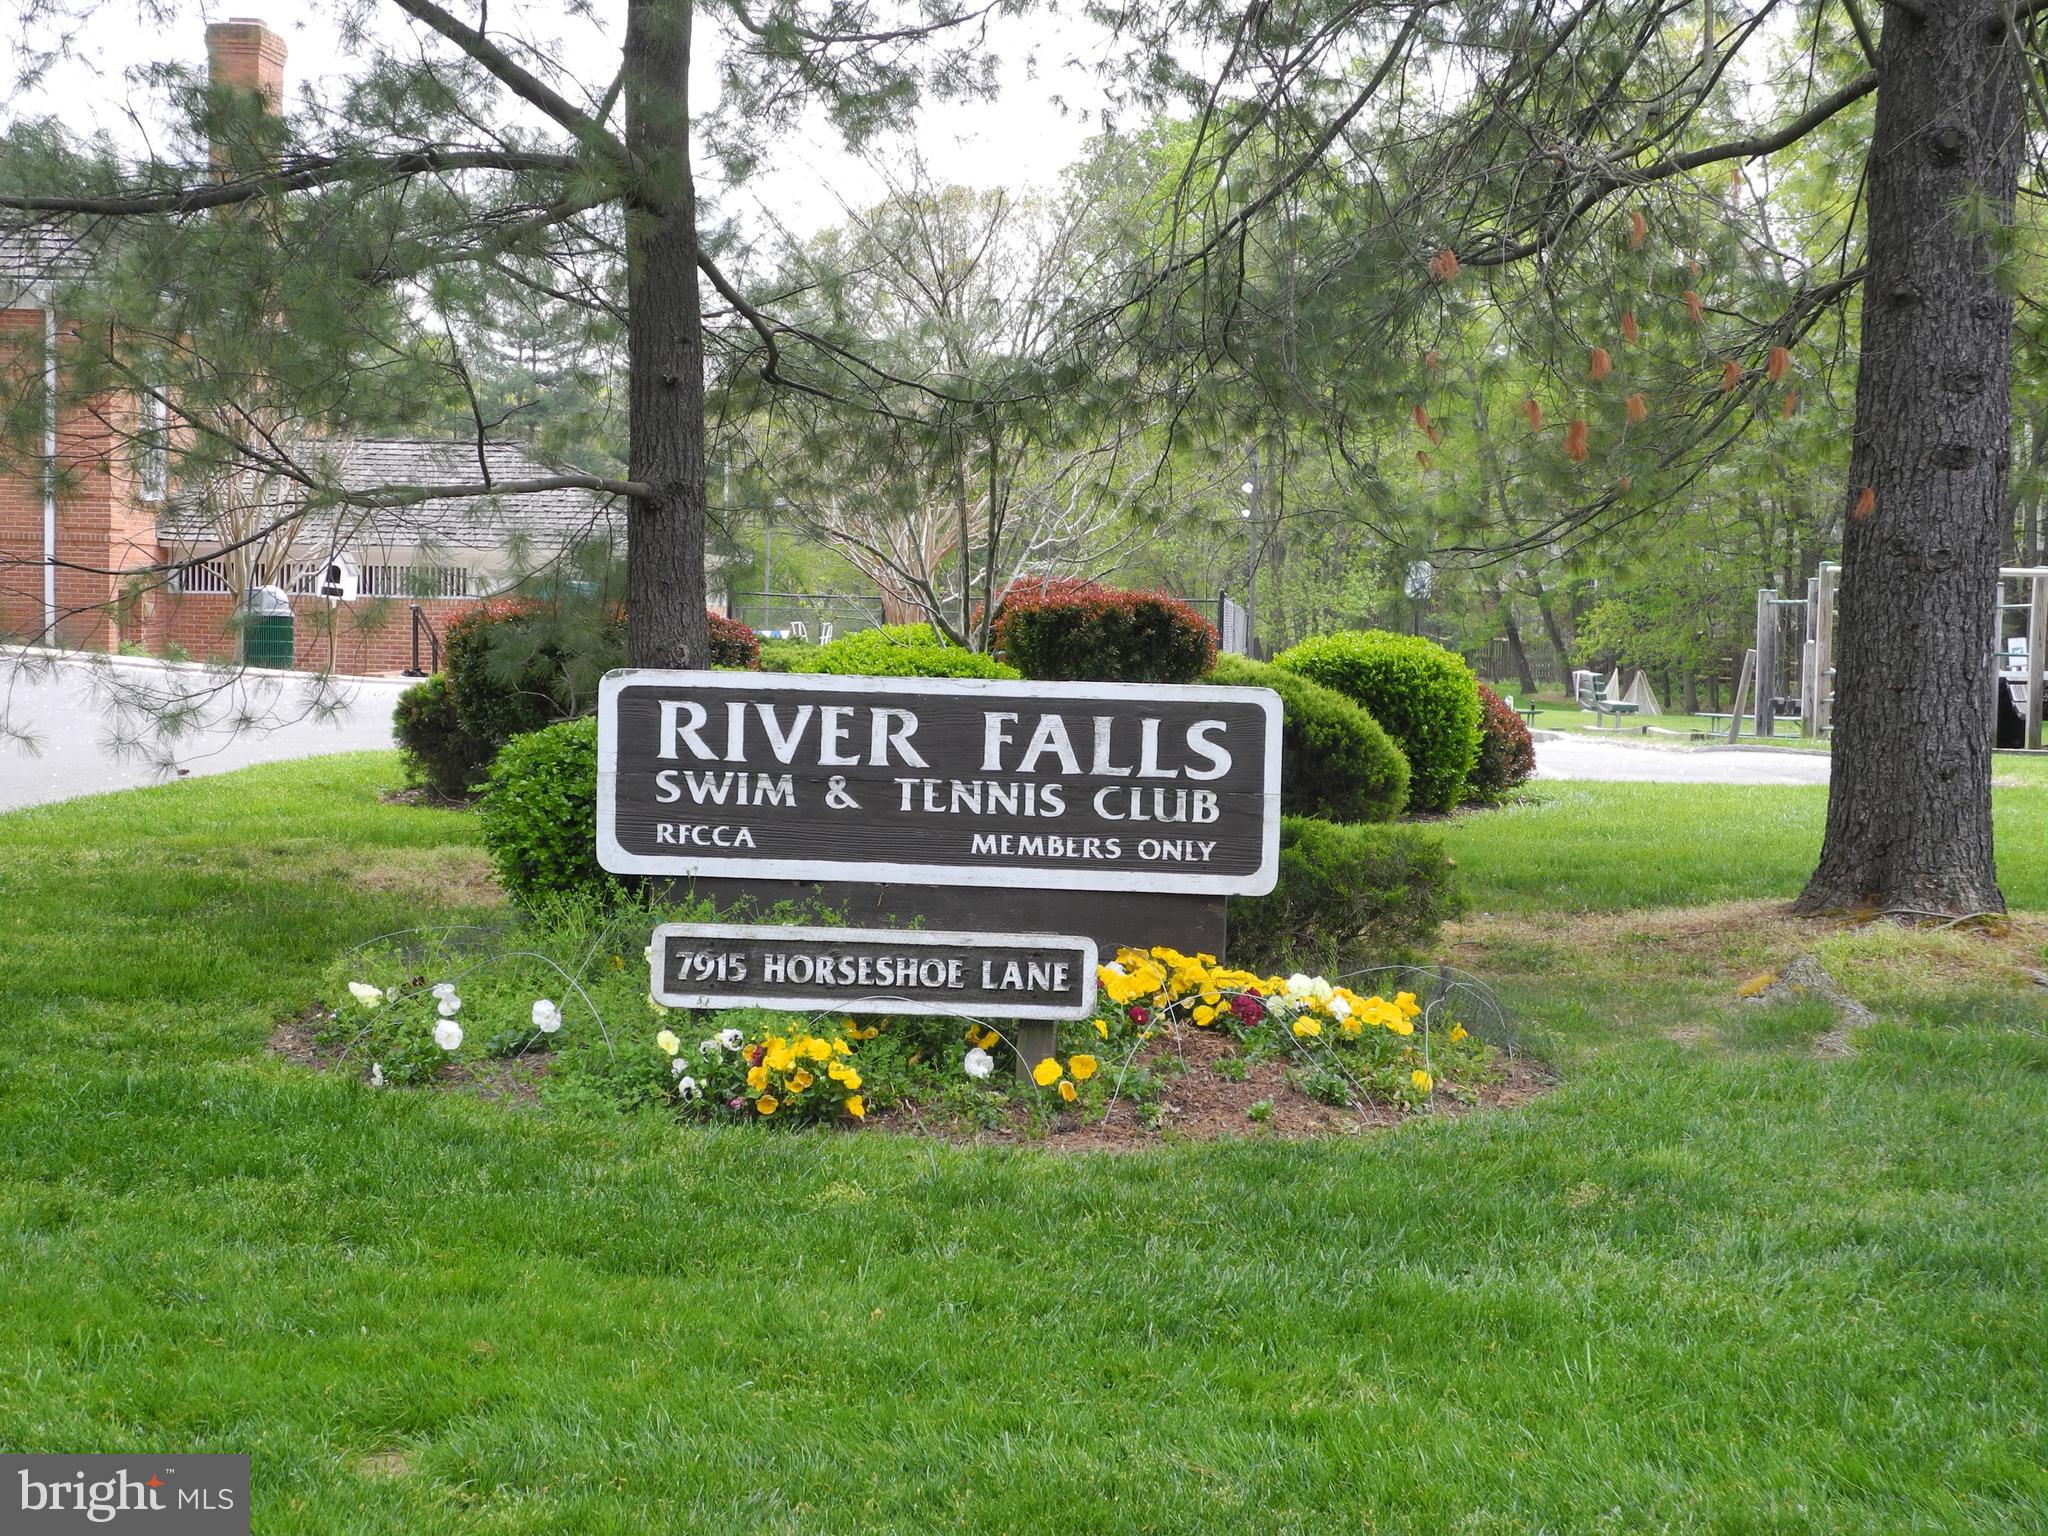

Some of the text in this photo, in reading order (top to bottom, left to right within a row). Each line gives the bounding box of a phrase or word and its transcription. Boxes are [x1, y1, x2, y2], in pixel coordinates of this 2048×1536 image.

[656, 699, 1233, 781] RIVER FALLS
[655, 769, 1221, 824] SWIM & TENNIS CLUB
[656, 823, 757, 848] RFCCA
[970, 834, 1217, 863] MEMBERS ONLY
[676, 951, 1072, 993] 7915 HORSESHOE LANE
